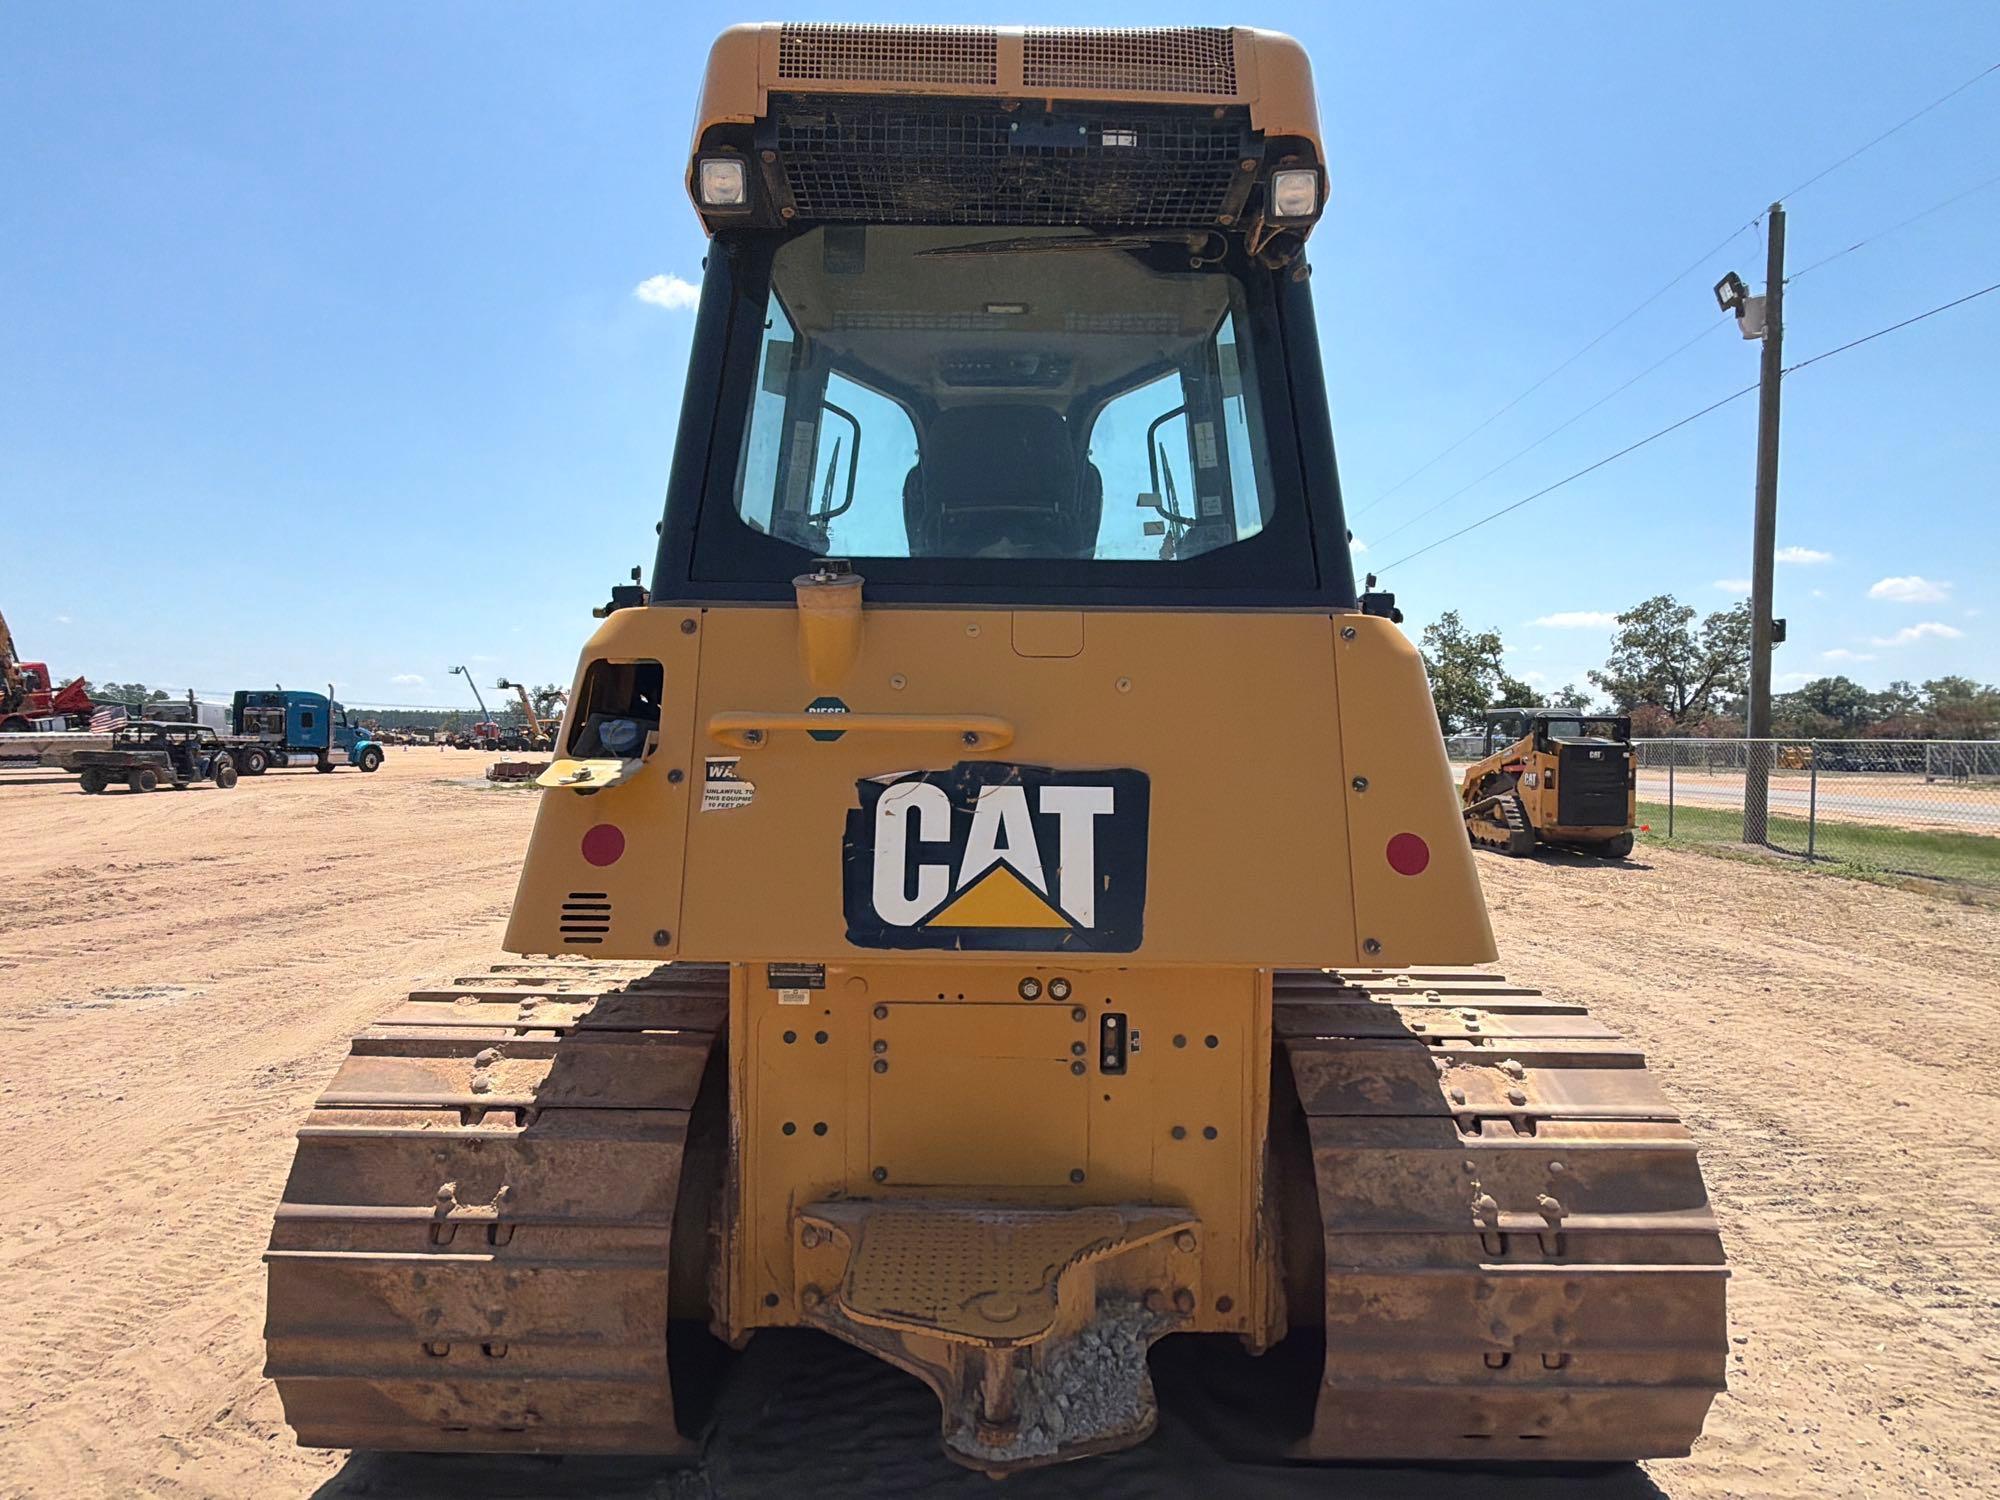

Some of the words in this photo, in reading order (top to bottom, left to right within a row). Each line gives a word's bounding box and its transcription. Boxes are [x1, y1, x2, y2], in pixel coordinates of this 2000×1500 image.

[709, 766, 737, 778] WA
[1525, 773, 1536, 786] CAT
[873, 782, 1114, 928] CAT
